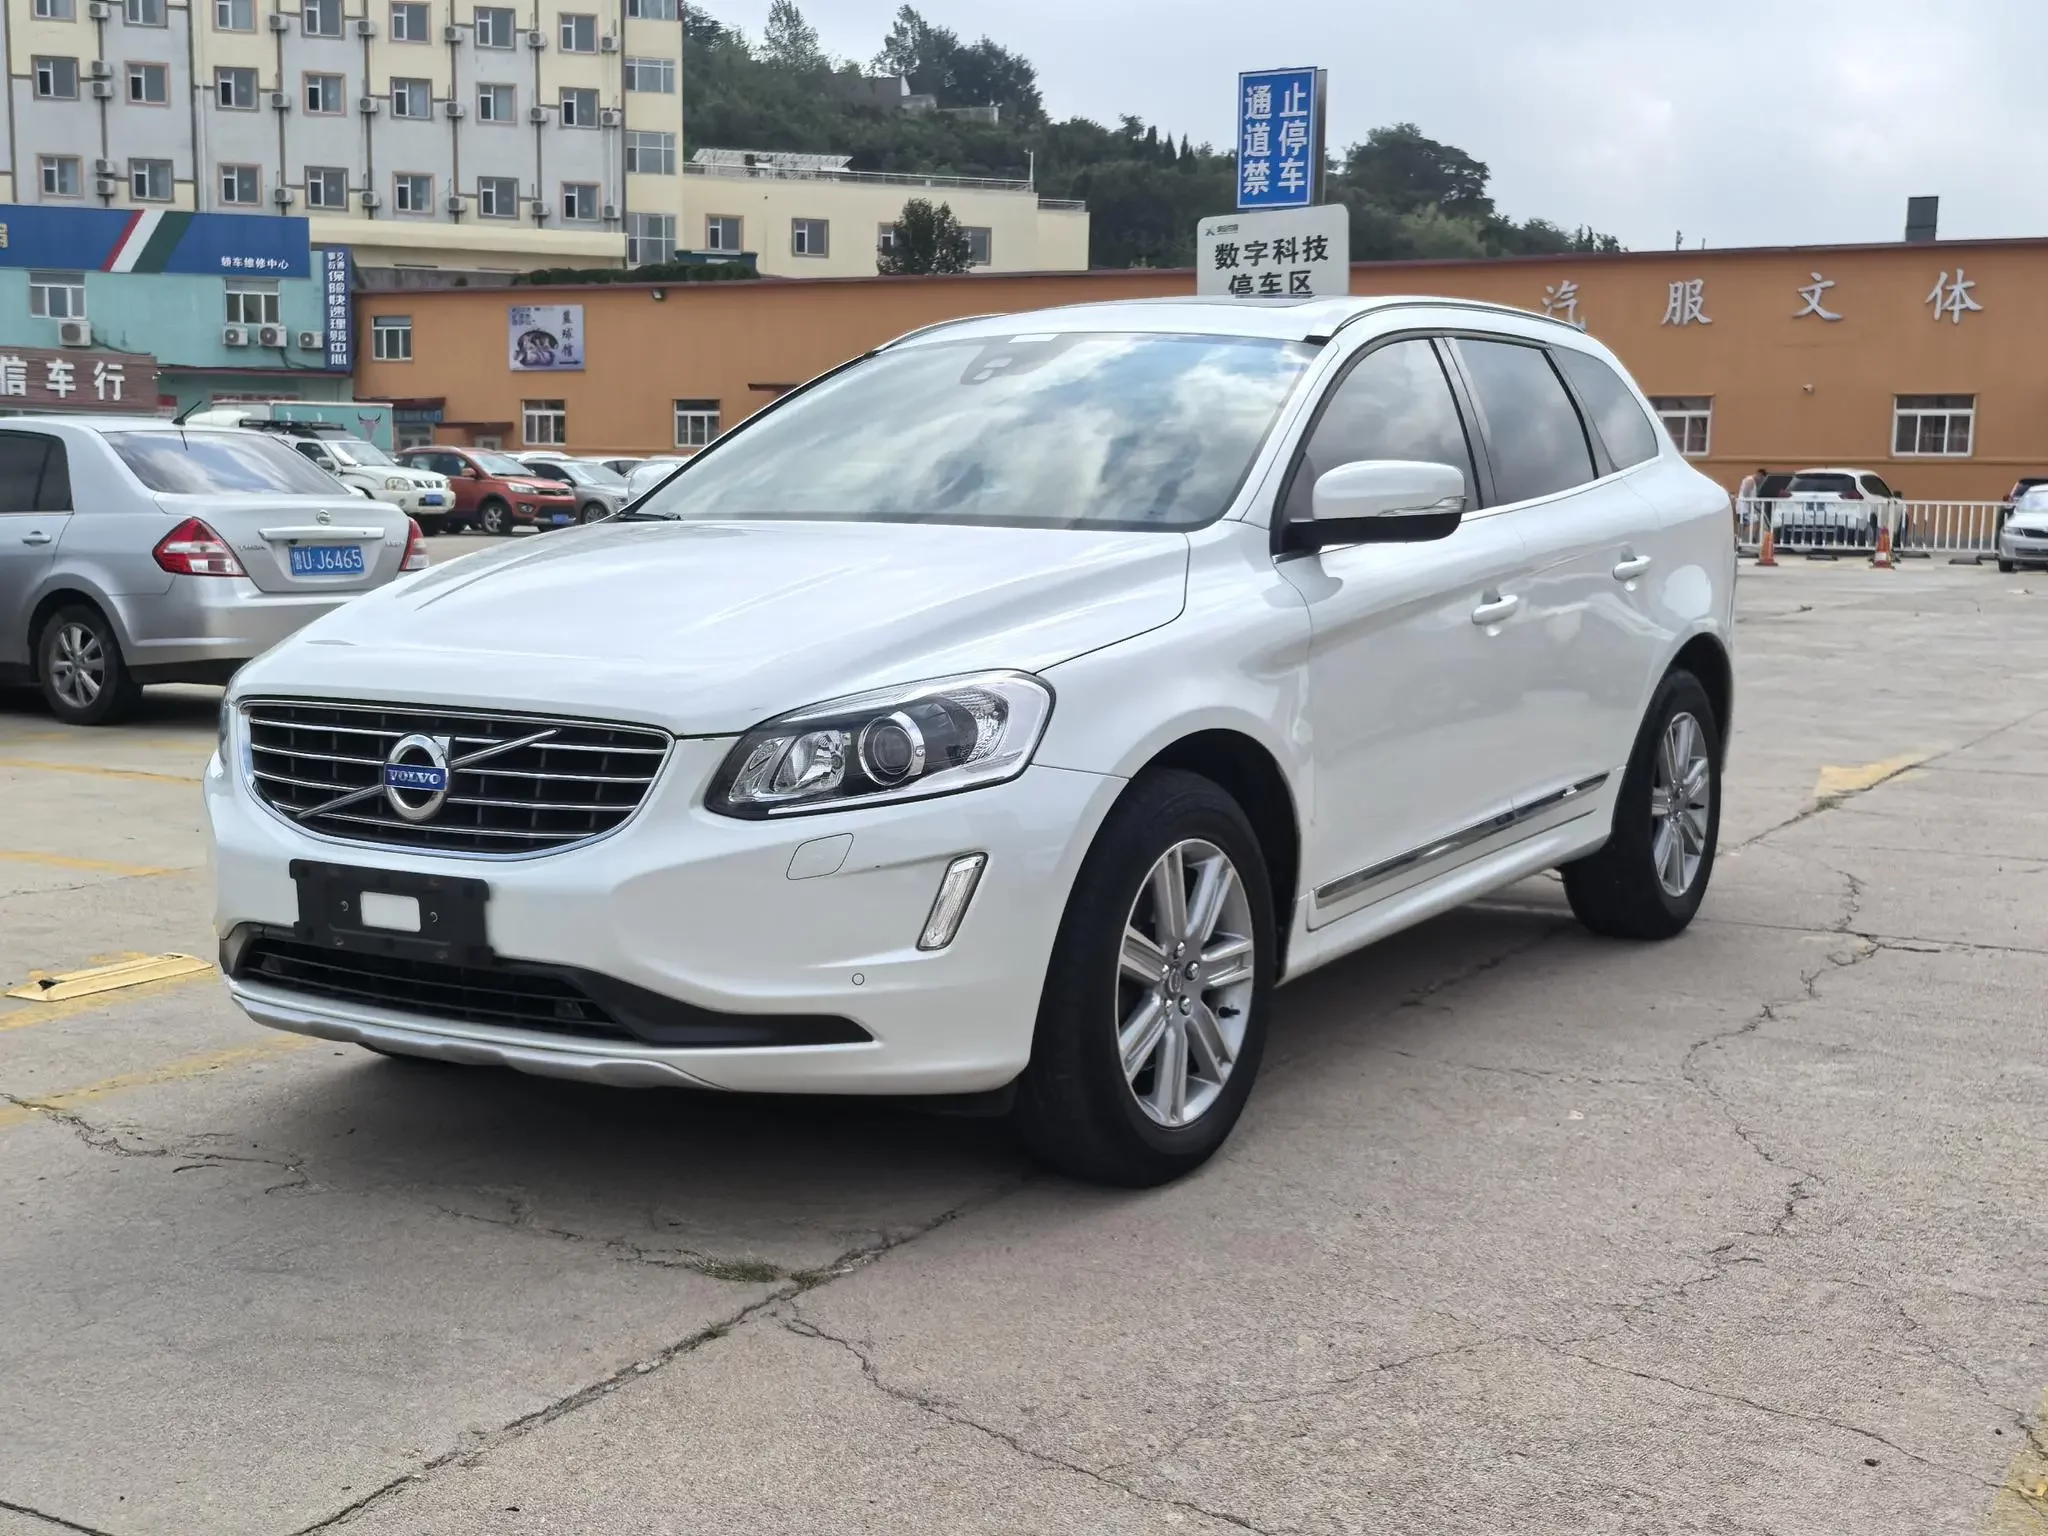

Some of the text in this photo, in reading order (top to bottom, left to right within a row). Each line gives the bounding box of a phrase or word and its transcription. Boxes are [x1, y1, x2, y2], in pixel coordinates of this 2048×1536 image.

[1243, 85, 1272, 196] 通道禁
[1278, 82, 1308, 194] 止停车
[1215, 235, 1329, 270] 数字科技
[1228, 270, 1313, 295] 停车区
[0, 356, 125, 401] 信车行
[388, 769, 441, 785] VOLVO
